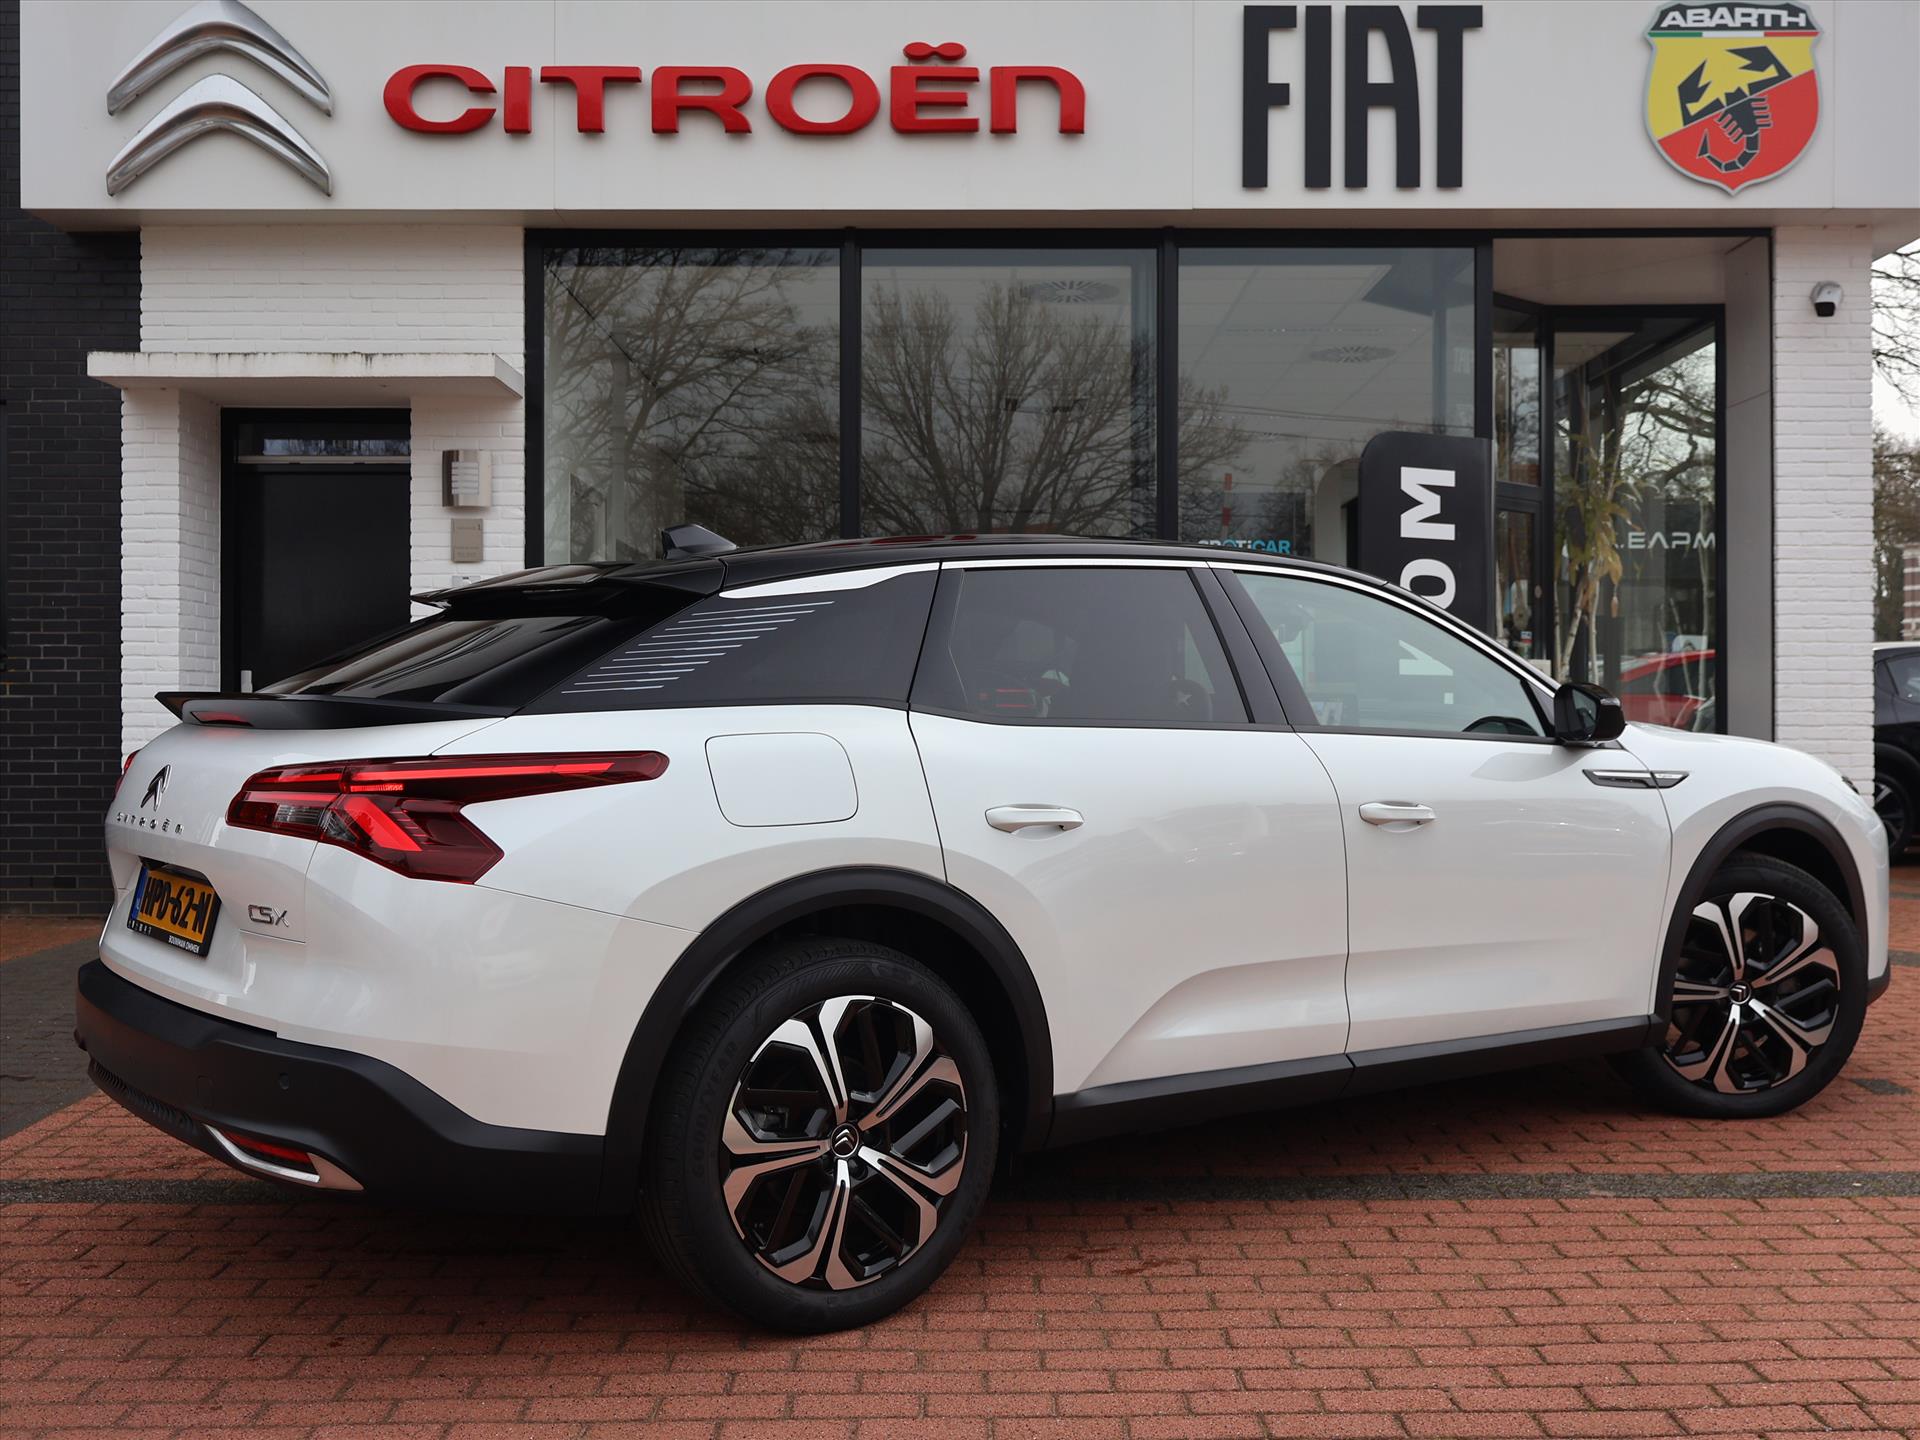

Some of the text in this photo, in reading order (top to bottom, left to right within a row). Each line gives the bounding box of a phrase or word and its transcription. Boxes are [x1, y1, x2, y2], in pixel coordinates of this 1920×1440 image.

[1660, 7, 1807, 28] ABARTH
[383, 42, 1087, 135] CITROËN
[1241, 5, 1484, 189] FIAT
[1615, 531, 1716, 550] EAPM
[691, 1040, 738, 1180] GOODYEAR
